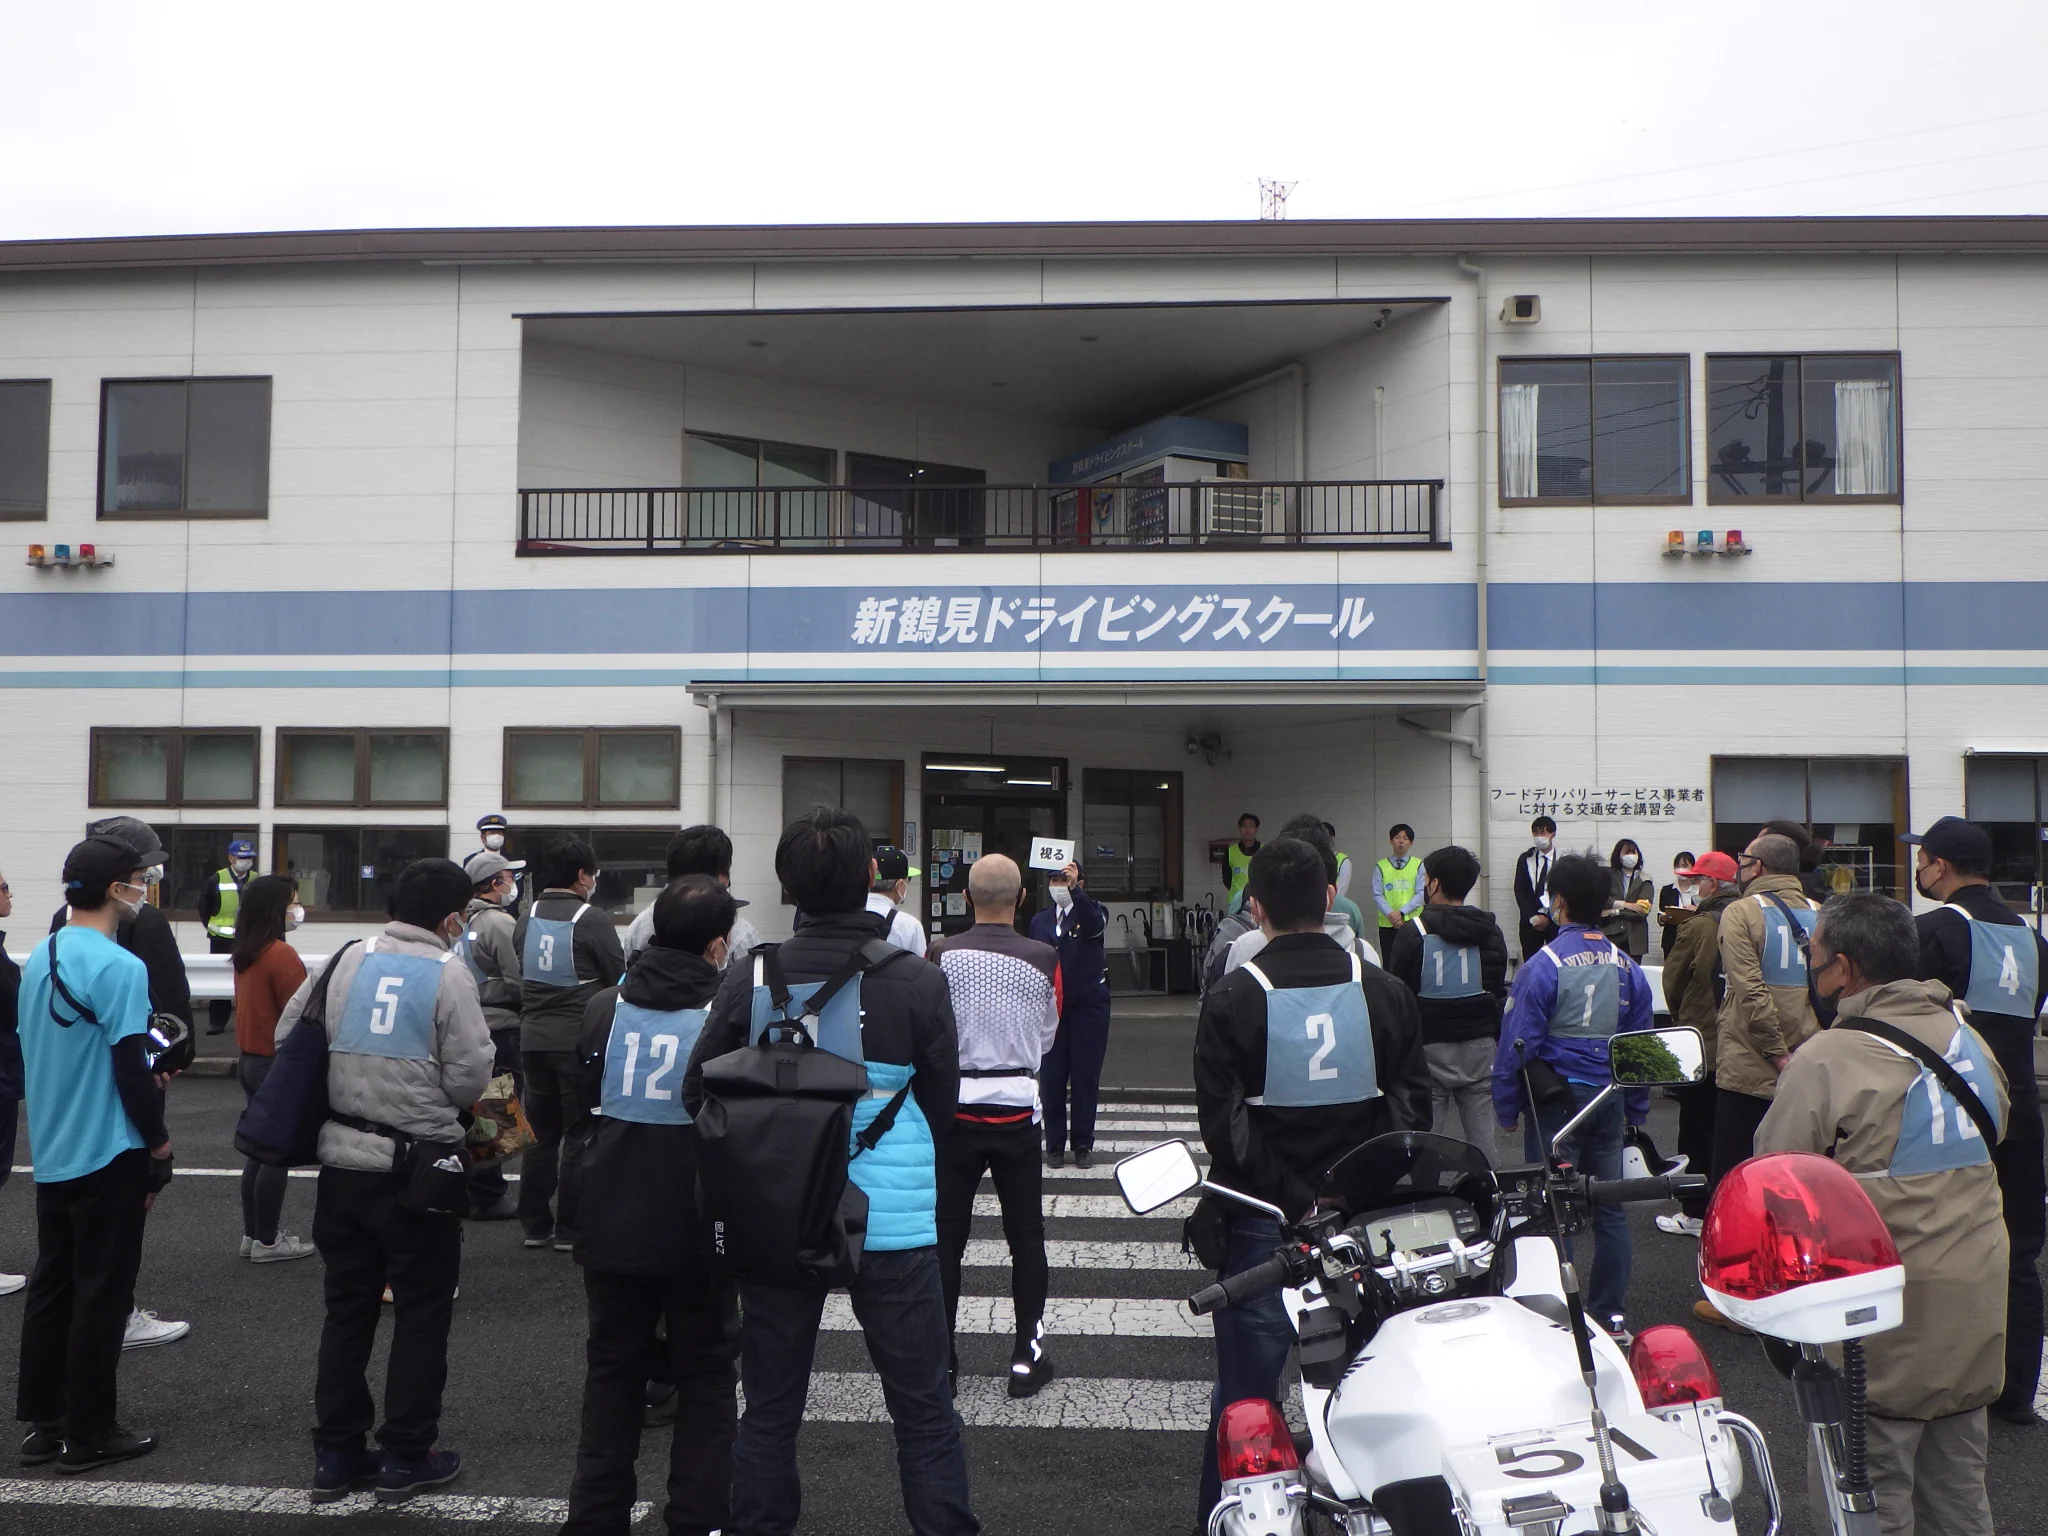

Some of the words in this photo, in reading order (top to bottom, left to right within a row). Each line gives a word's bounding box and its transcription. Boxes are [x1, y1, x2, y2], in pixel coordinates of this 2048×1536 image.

[851, 594, 1374, 643] 新鶴見ドライビングスクール
[1491, 788, 1705, 802] フードデリバリーサービス事業者
[1519, 803, 1676, 816] に対する交通安全講習会
[1040, 846, 1064, 861] 視る
[538, 934, 554, 972] 3
[1432, 947, 1469, 987] 11
[1998, 945, 2020, 996] 4
[369, 976, 404, 1035] 5
[1581, 984, 1596, 1027] 1
[621, 1032, 680, 1101] 12
[1305, 1013, 1338, 1081] 2
